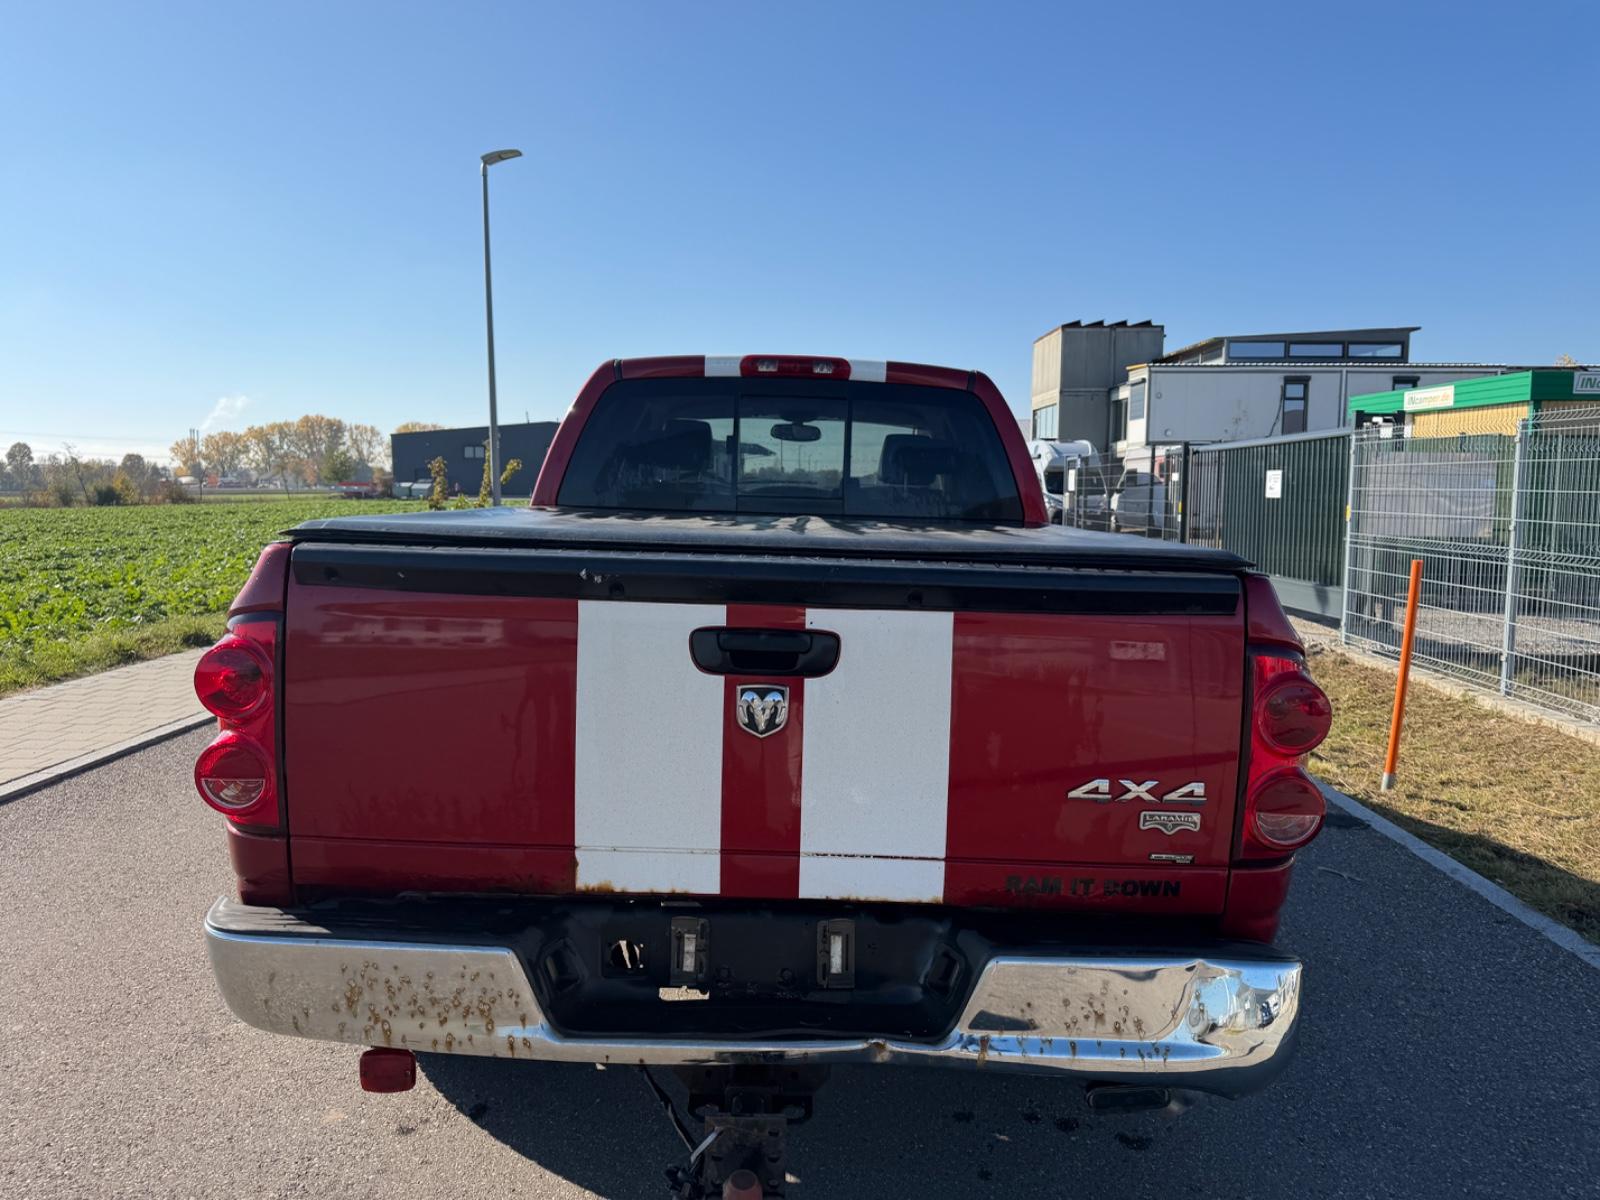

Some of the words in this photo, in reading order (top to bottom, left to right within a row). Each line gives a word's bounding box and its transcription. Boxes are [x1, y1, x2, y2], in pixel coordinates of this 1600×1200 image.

[1067, 778, 1208, 804] 4X4
[1005, 875, 1063, 895] RAM
[1071, 878, 1095, 896] IT
[1103, 879, 1181, 897] DOWN
